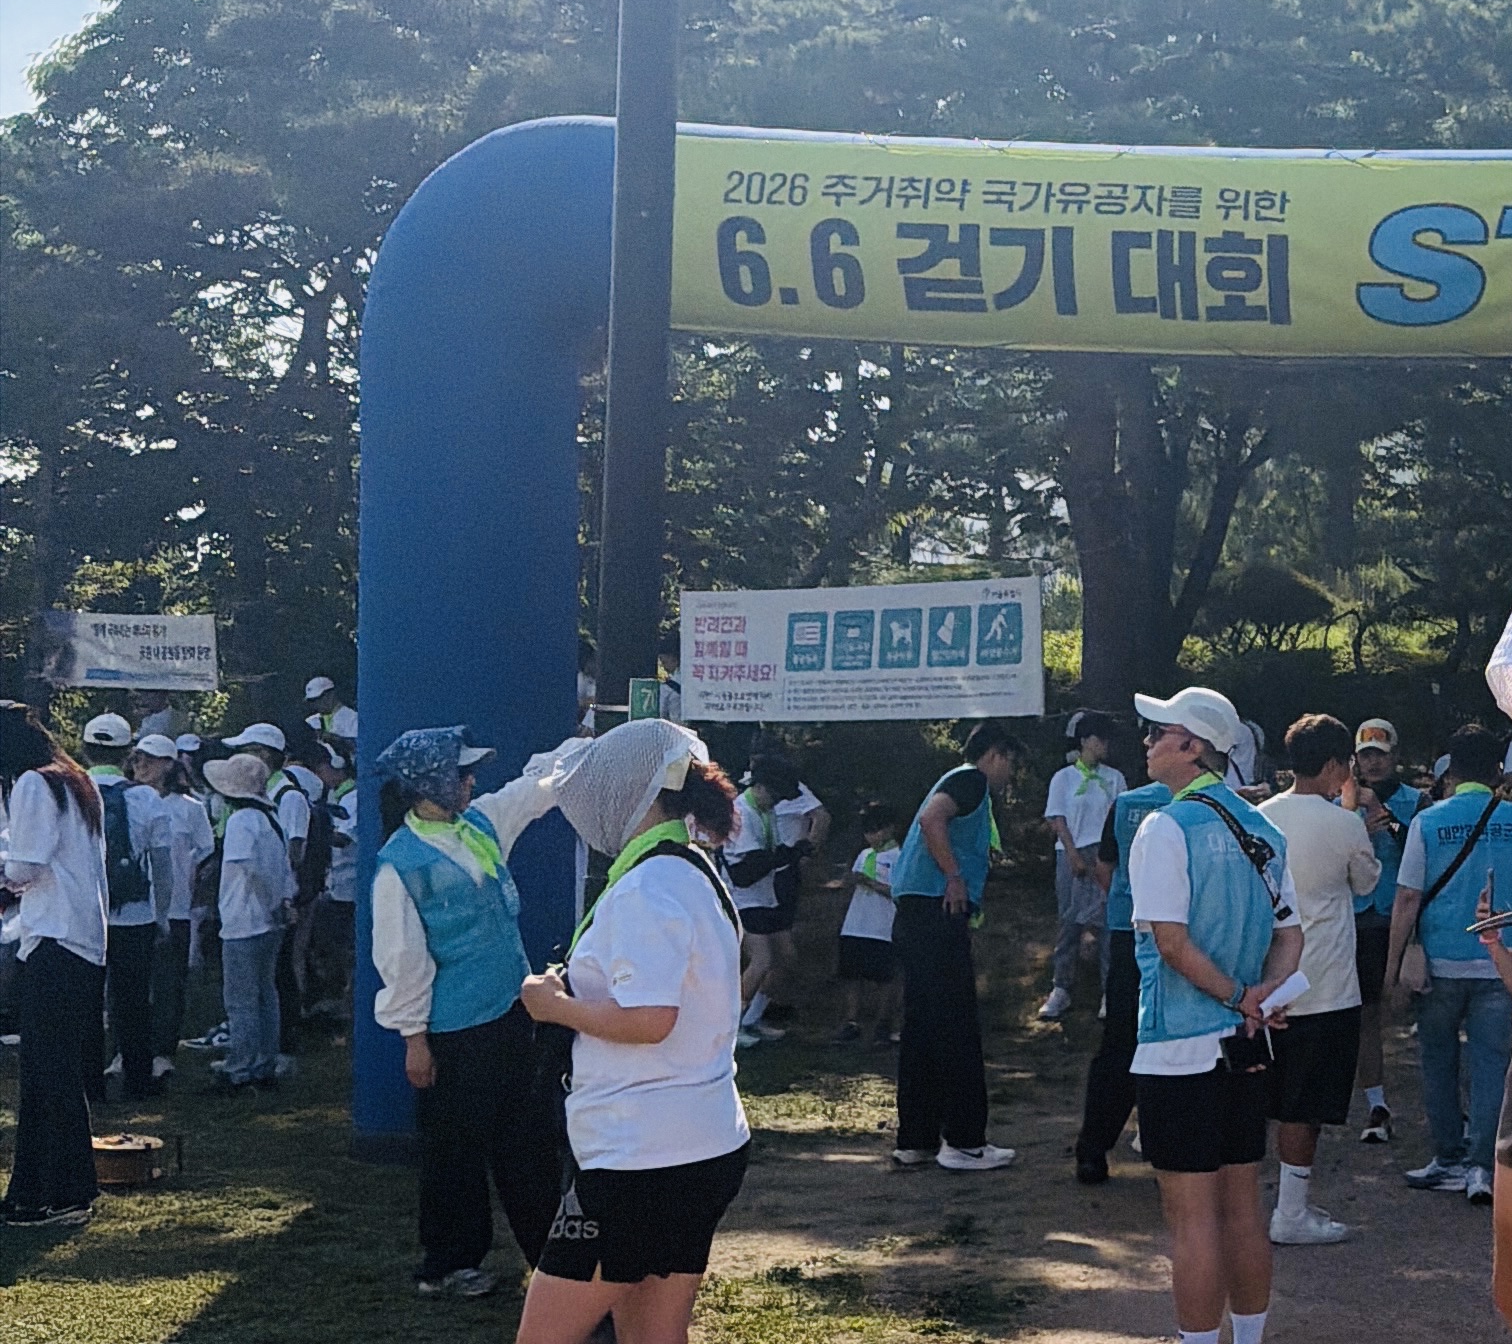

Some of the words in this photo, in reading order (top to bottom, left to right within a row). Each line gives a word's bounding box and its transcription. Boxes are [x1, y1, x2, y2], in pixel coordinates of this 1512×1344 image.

[723, 170, 812, 208] 2026
[820, 175, 972, 212] 주거취약
[981, 180, 1204, 221] 국가유공자를
[1216, 188, 1293, 224] 위한
[716, 216, 868, 310] 6.6
[896, 222, 1080, 317] 걷기
[1112, 229, 1293, 326] 대회
